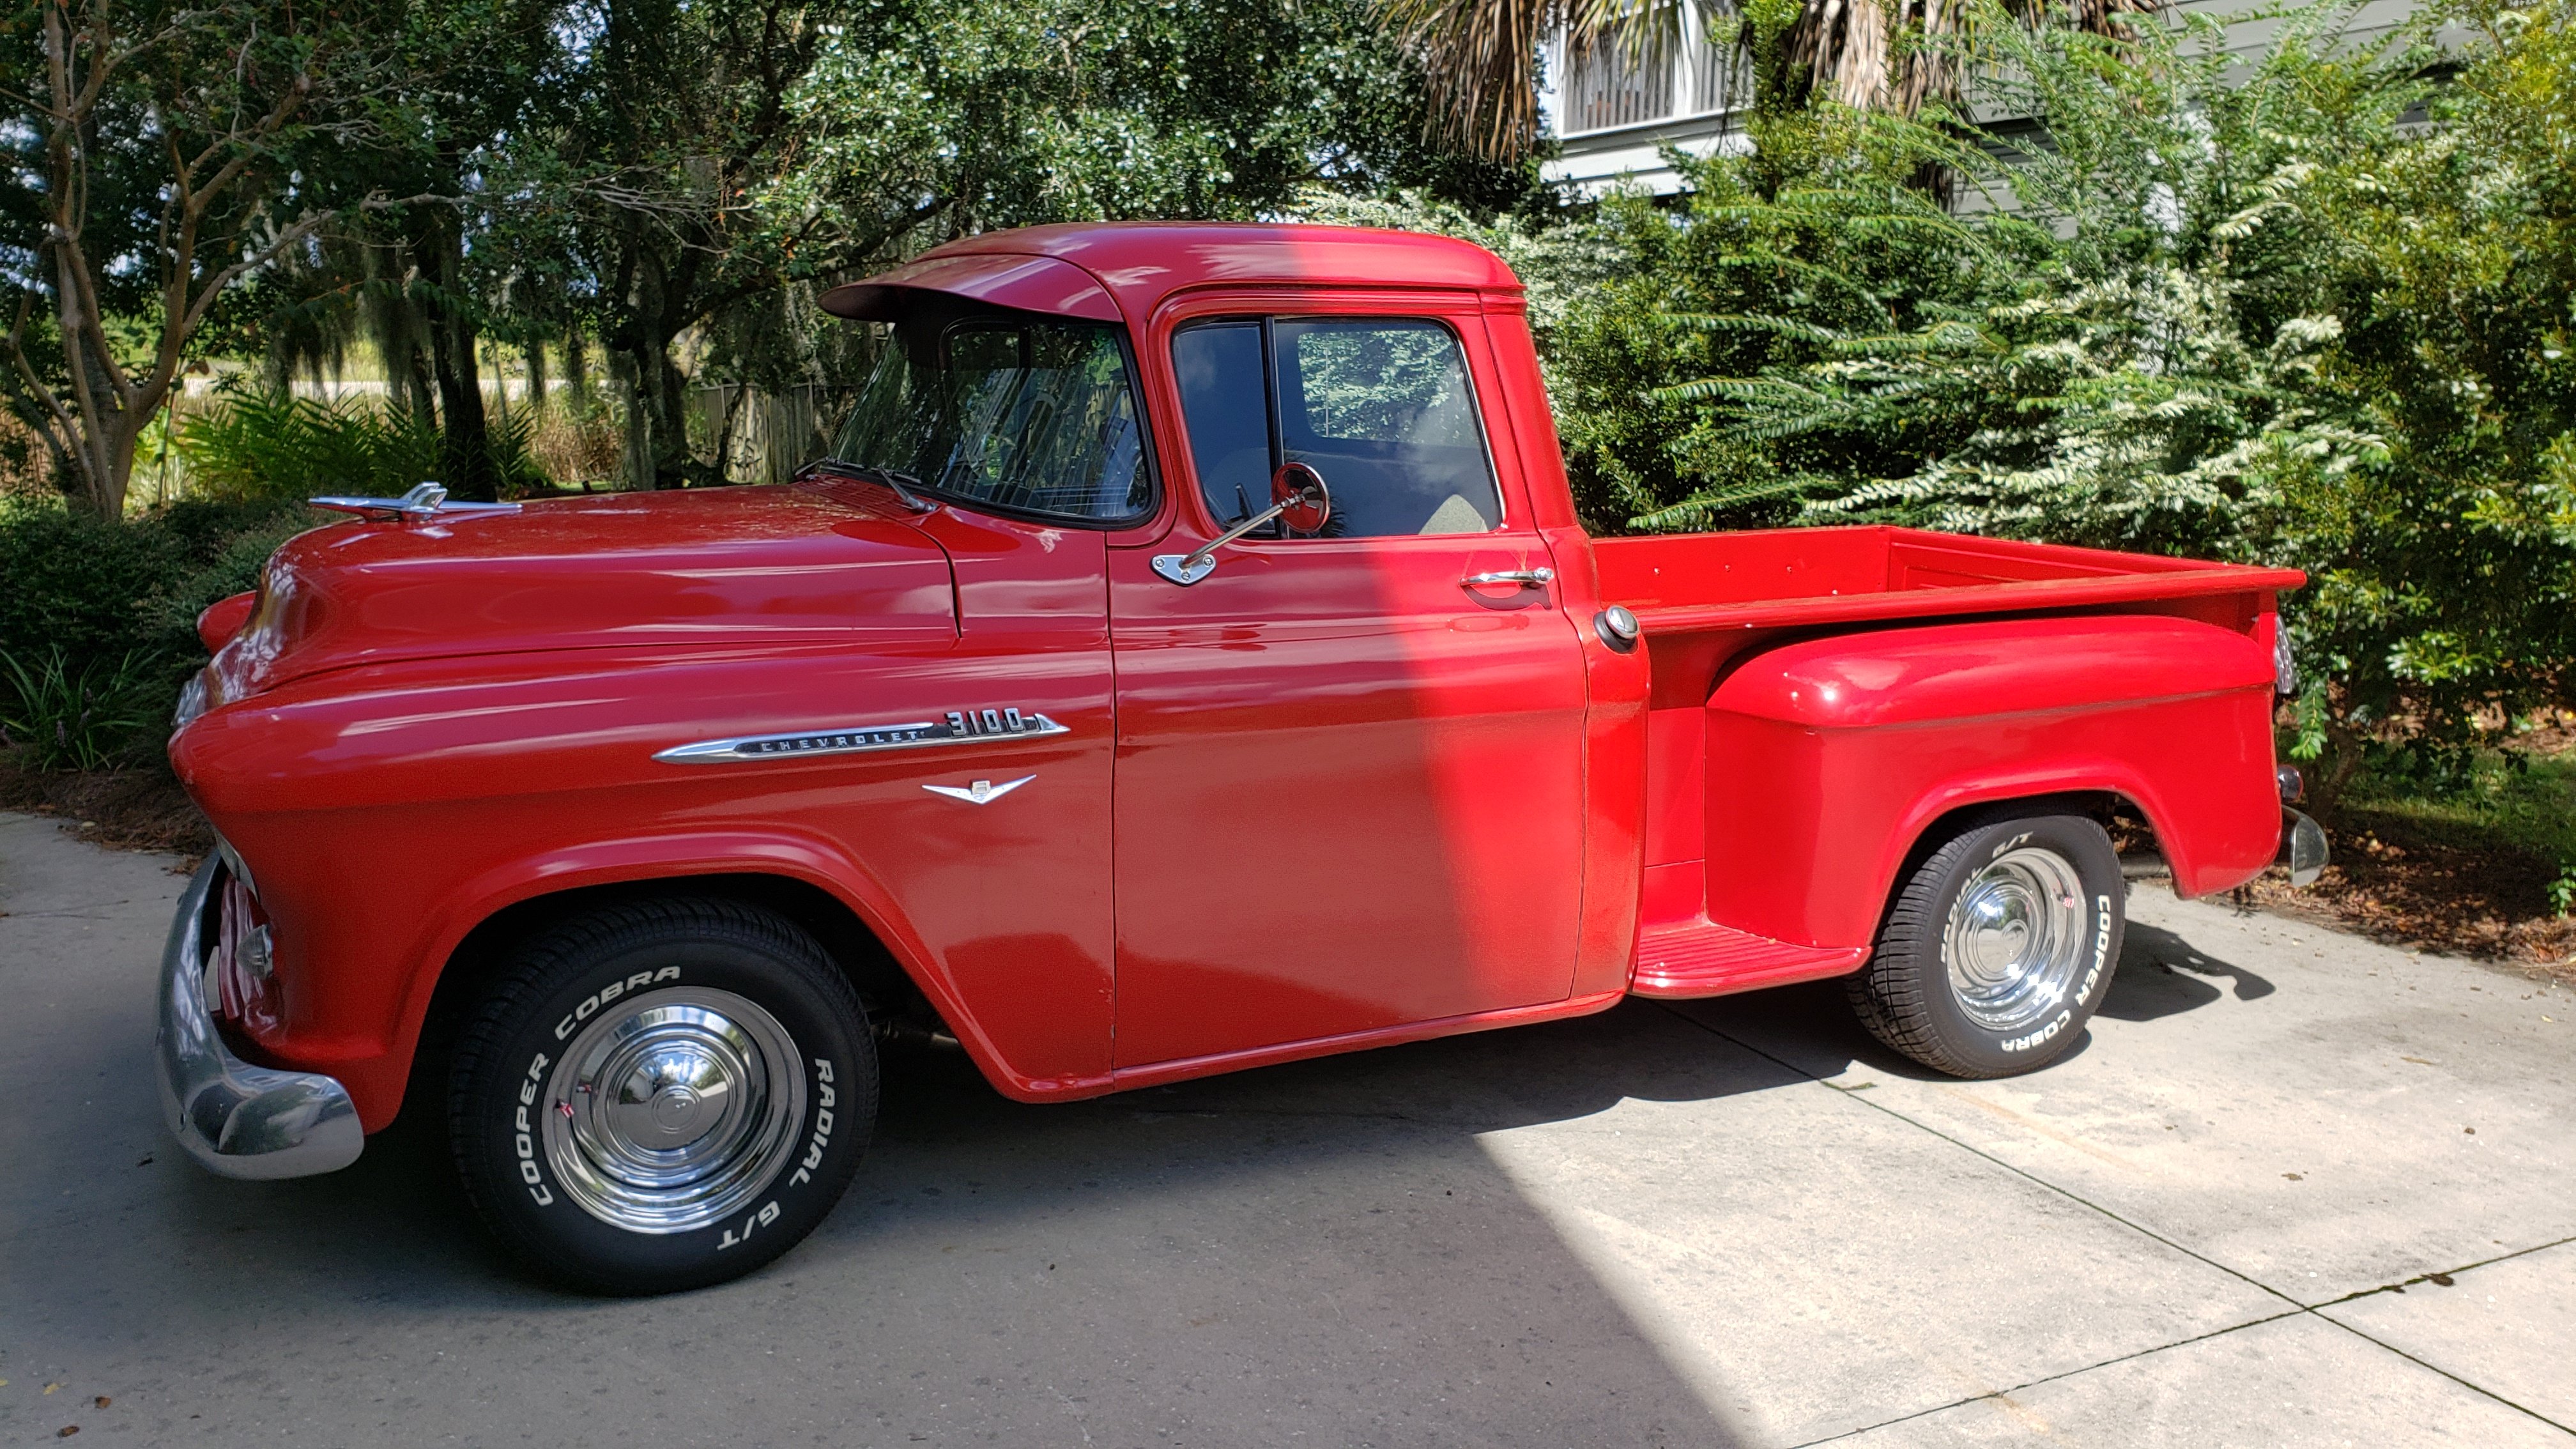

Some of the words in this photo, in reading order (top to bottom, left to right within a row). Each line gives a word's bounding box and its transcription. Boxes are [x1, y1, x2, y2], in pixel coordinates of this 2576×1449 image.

[762, 731, 918, 752] CHEVROLET
[945, 707, 1023, 736] 3100
[1991, 831, 2034, 859] G/T
[2074, 894, 2112, 1007] COOPER
[2000, 1009, 2071, 1052] COBRA
[515, 1052, 554, 1207] COOPER
[555, 965, 682, 1041] COBRA
[788, 1057, 836, 1188] RADIAL
[716, 1200, 781, 1252] G/T
